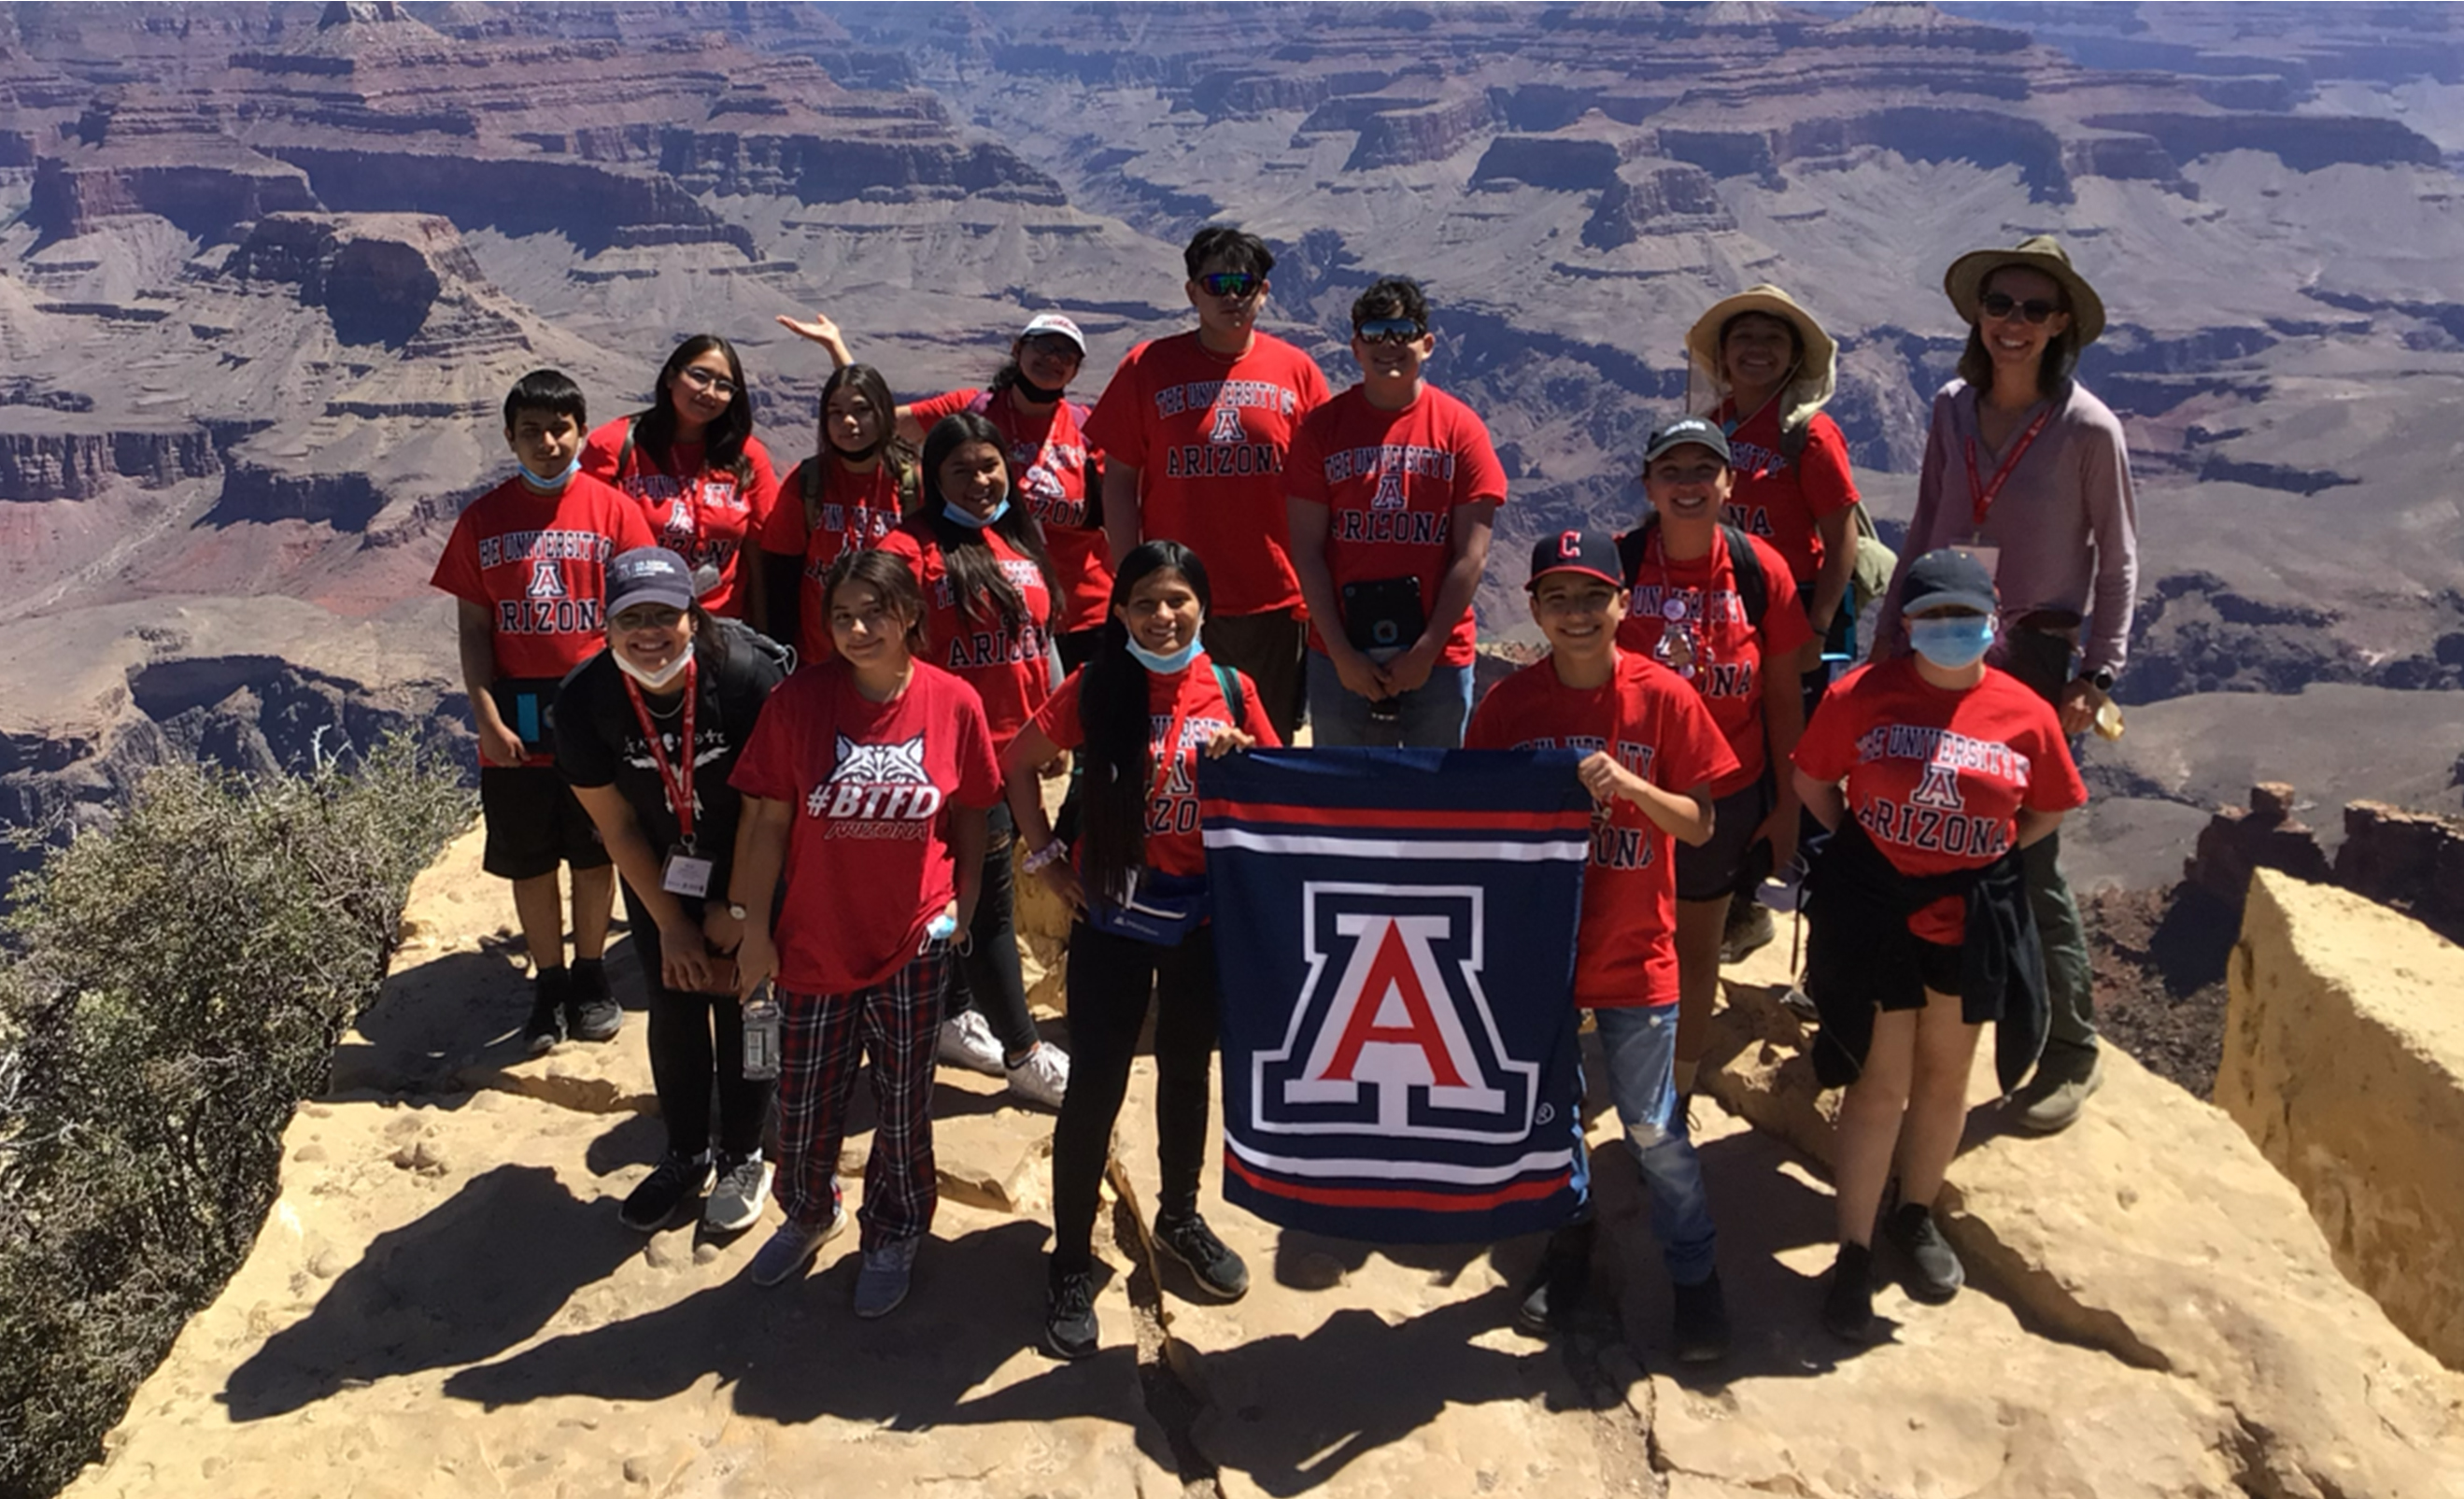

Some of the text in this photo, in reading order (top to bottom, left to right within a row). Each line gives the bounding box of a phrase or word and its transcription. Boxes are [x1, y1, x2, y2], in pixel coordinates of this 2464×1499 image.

[1155, 385, 1185, 419] THE
[1187, 379, 1278, 410] UNIVERSITY
[1209, 407, 1247, 444] A
[1371, 474, 1407, 510] A
[479, 535, 502, 571] HE
[1558, 529, 1581, 559] C
[527, 560, 568, 599] A
[499, 599, 607, 634] RIZON
[1889, 724, 2015, 780] UNIVERSITY
[807, 783, 942, 821] #BTFD
[1910, 764, 1965, 812] A
[824, 821, 927, 841] ARIZONA
[1253, 882, 1539, 1144] A
